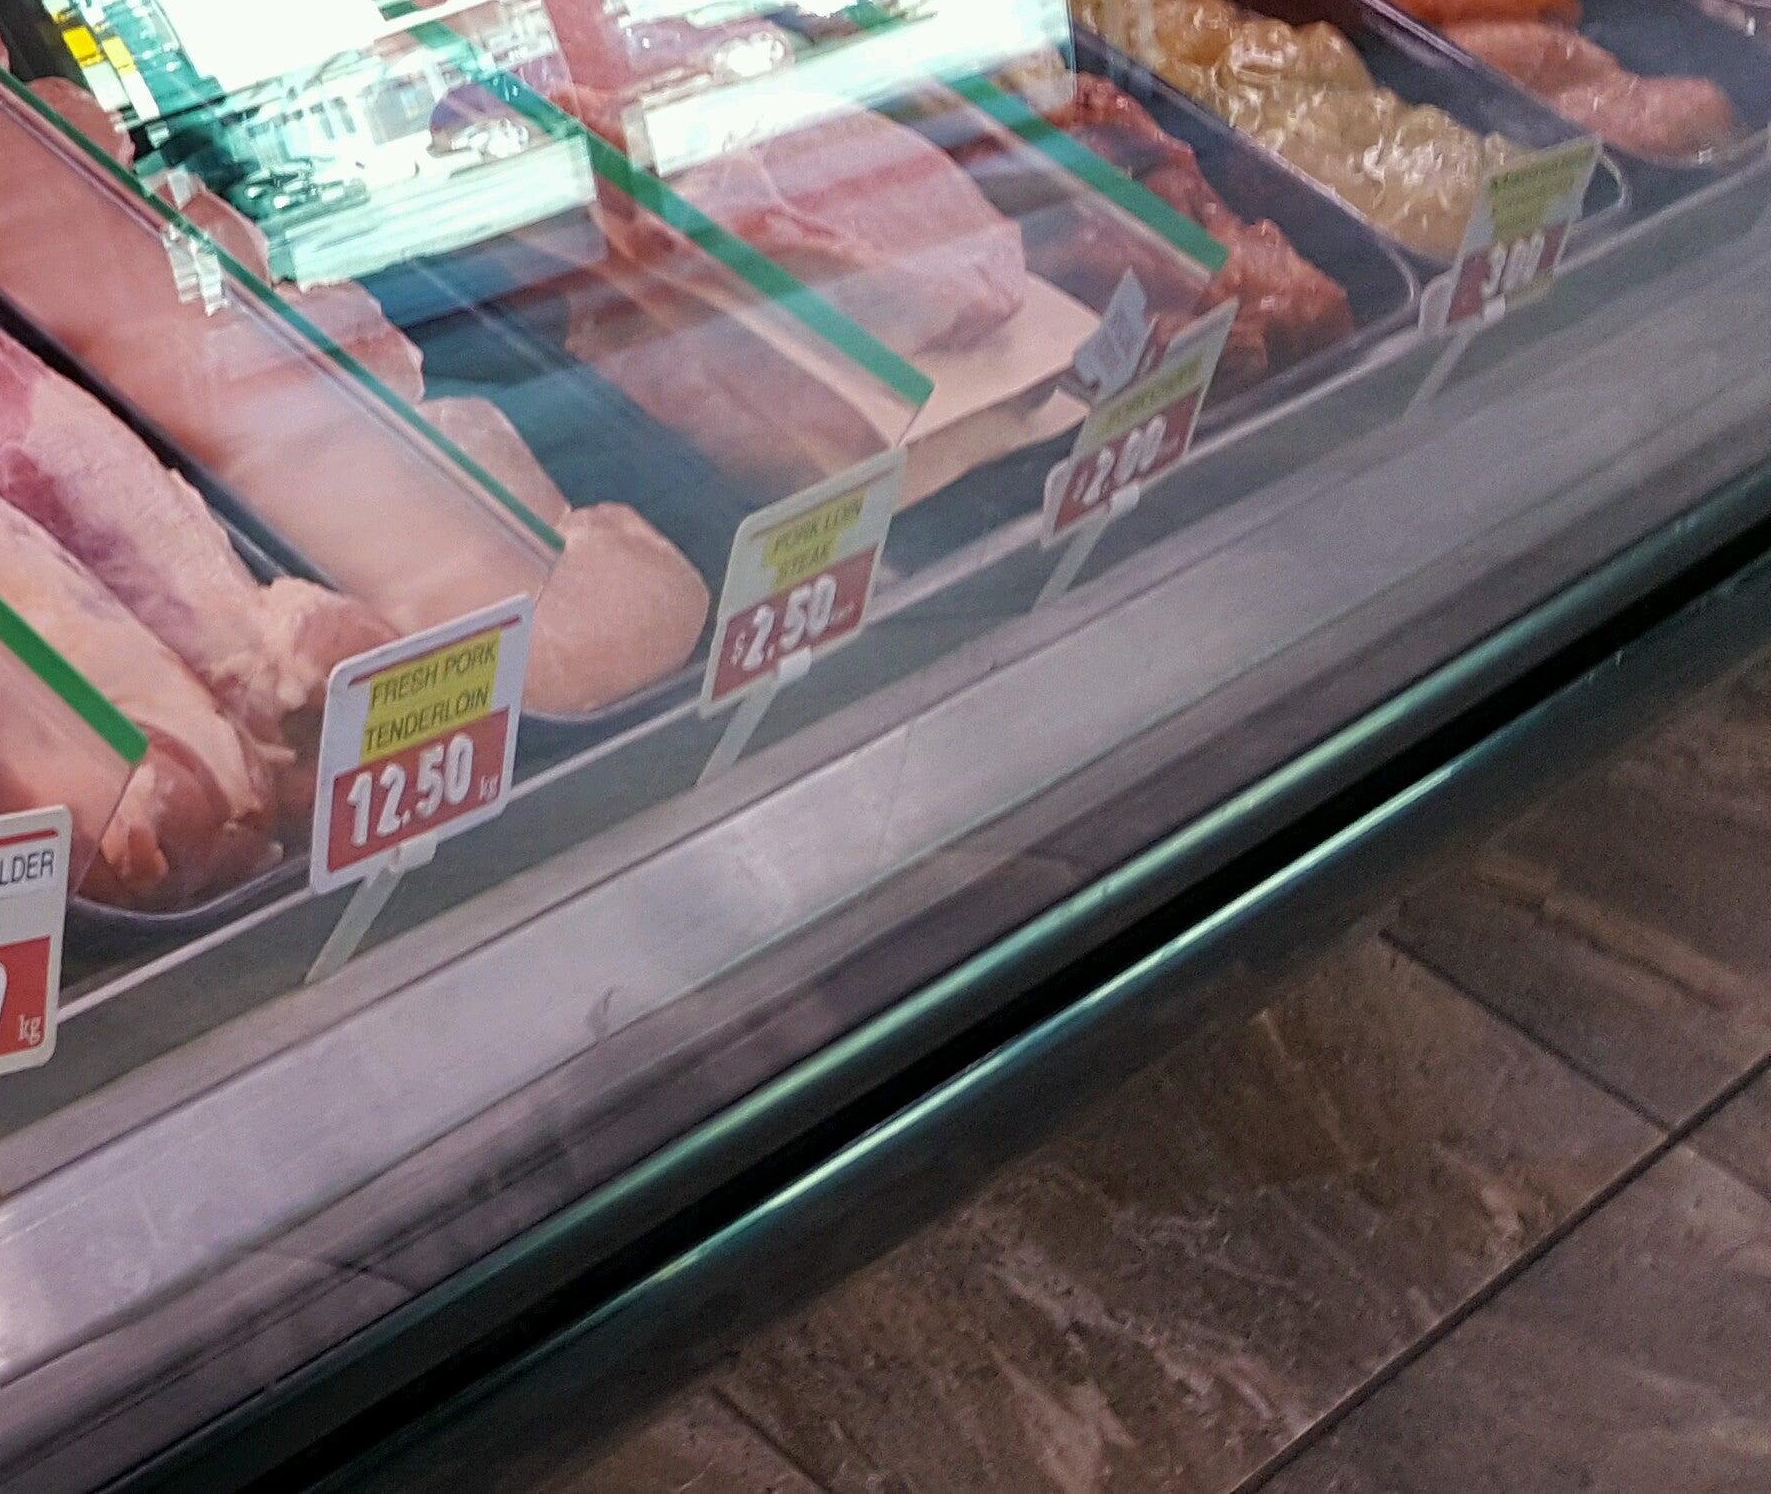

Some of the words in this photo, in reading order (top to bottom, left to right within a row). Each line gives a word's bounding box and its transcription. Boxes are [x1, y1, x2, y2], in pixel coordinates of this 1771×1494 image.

[370, 661, 438, 708] FRESH
[444, 641, 500, 678] PORK
[365, 683, 490, 752] TENDERLOIN
[347, 733, 474, 848] 12.50
[17, 1012, 43, 1046] kg
